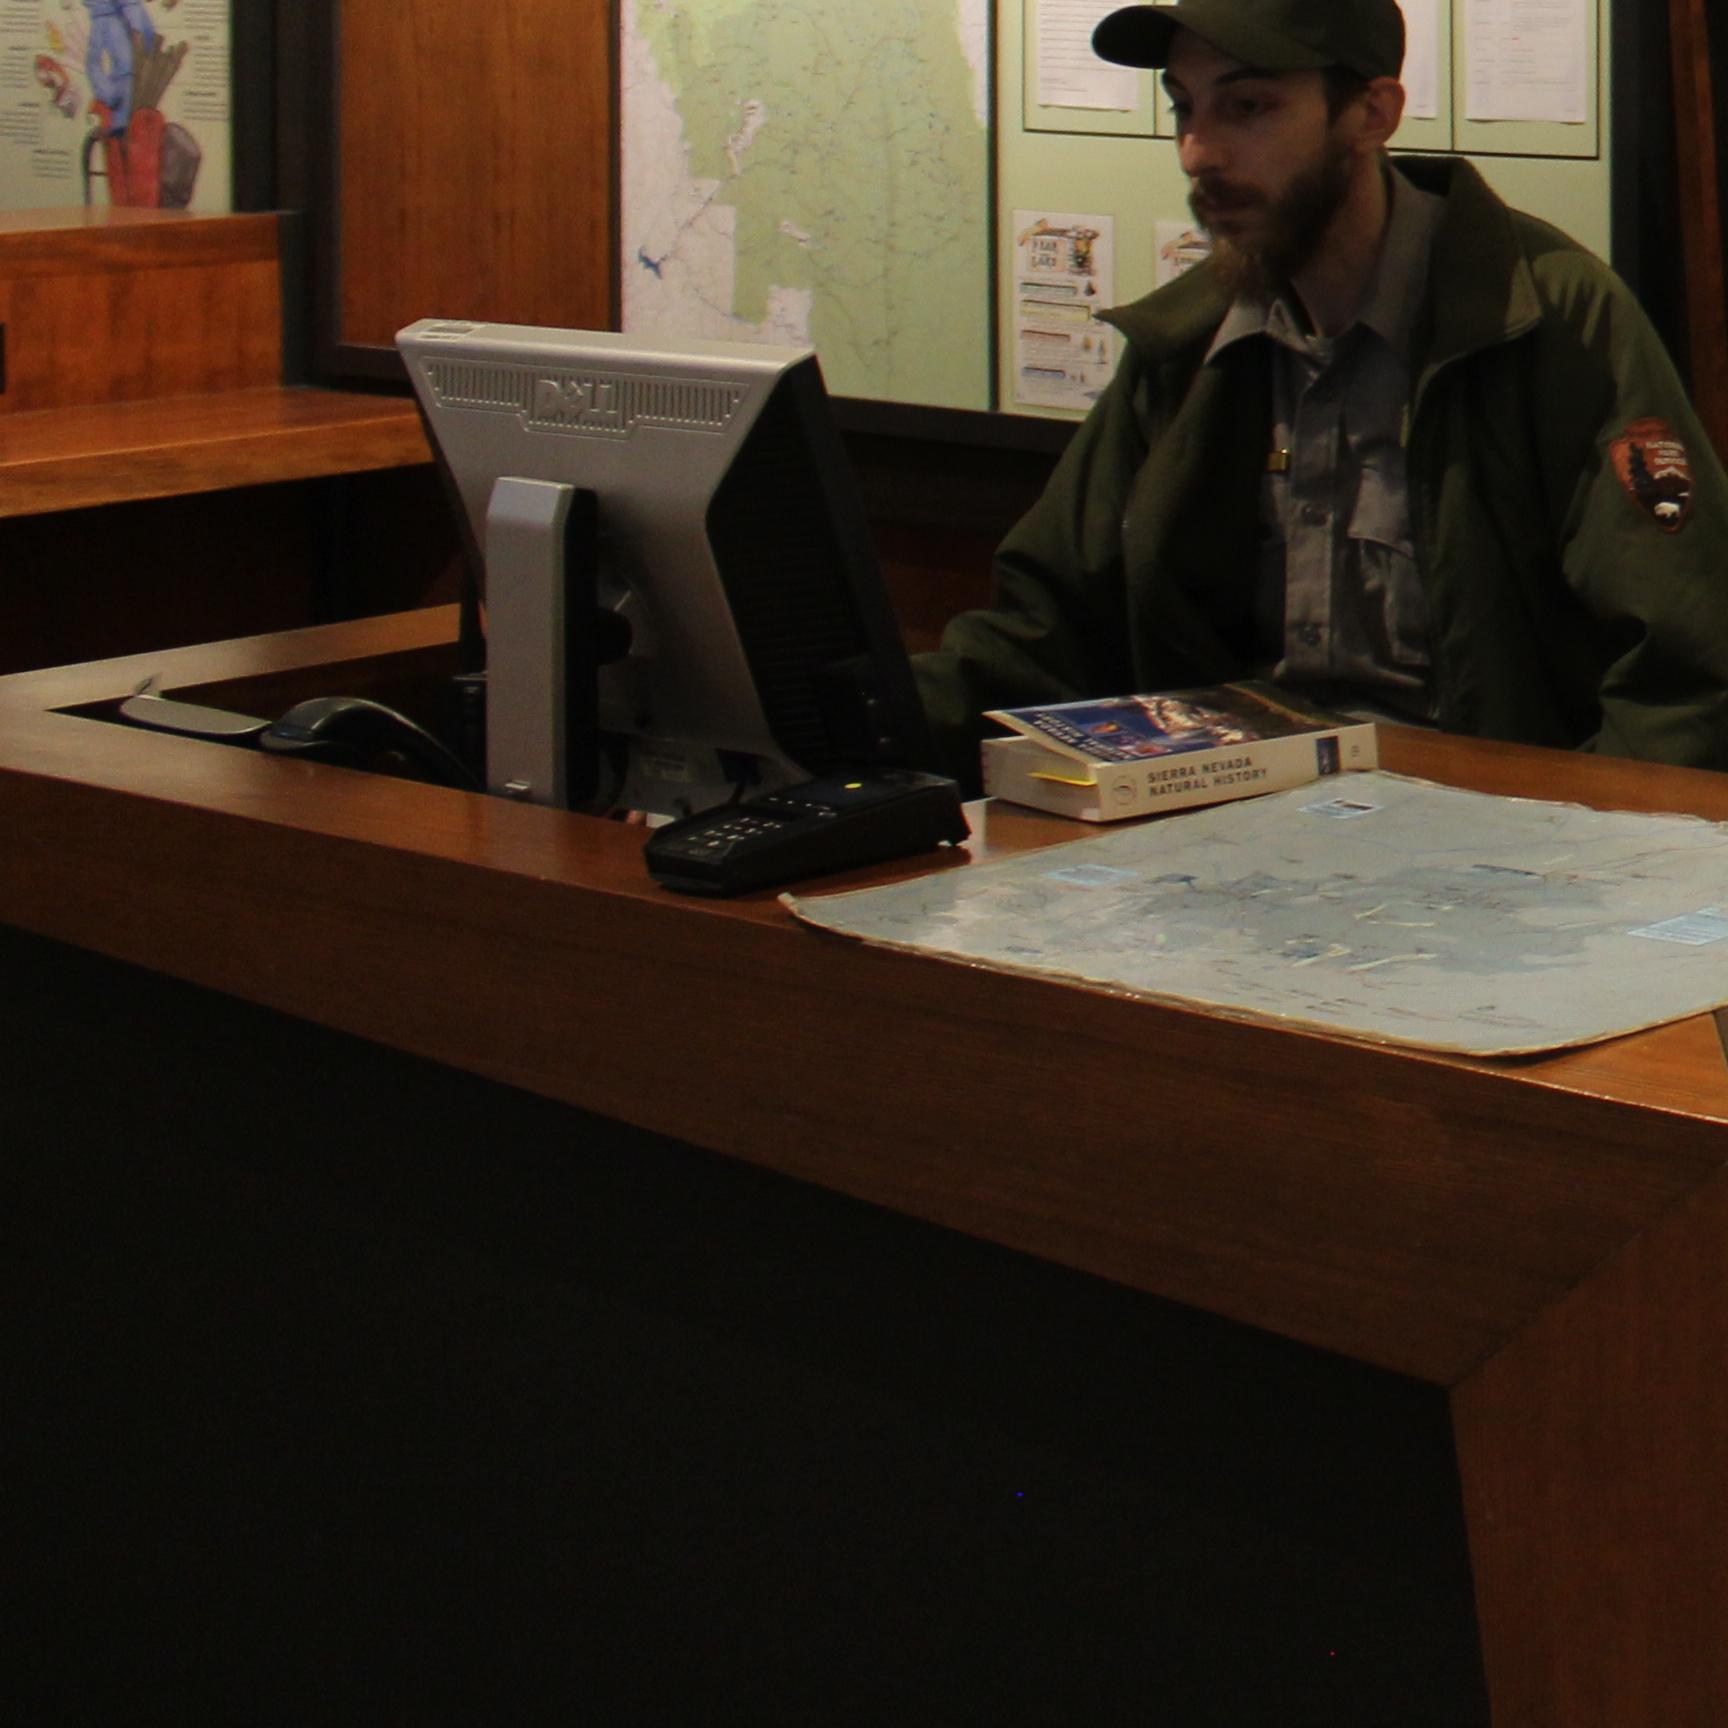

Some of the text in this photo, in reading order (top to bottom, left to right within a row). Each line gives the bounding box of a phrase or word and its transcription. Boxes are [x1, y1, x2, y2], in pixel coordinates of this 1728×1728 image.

[1147, 756, 1252, 783] SIERRA NEVADA
[1149, 768, 1268, 797] NATURAL HISTORY
